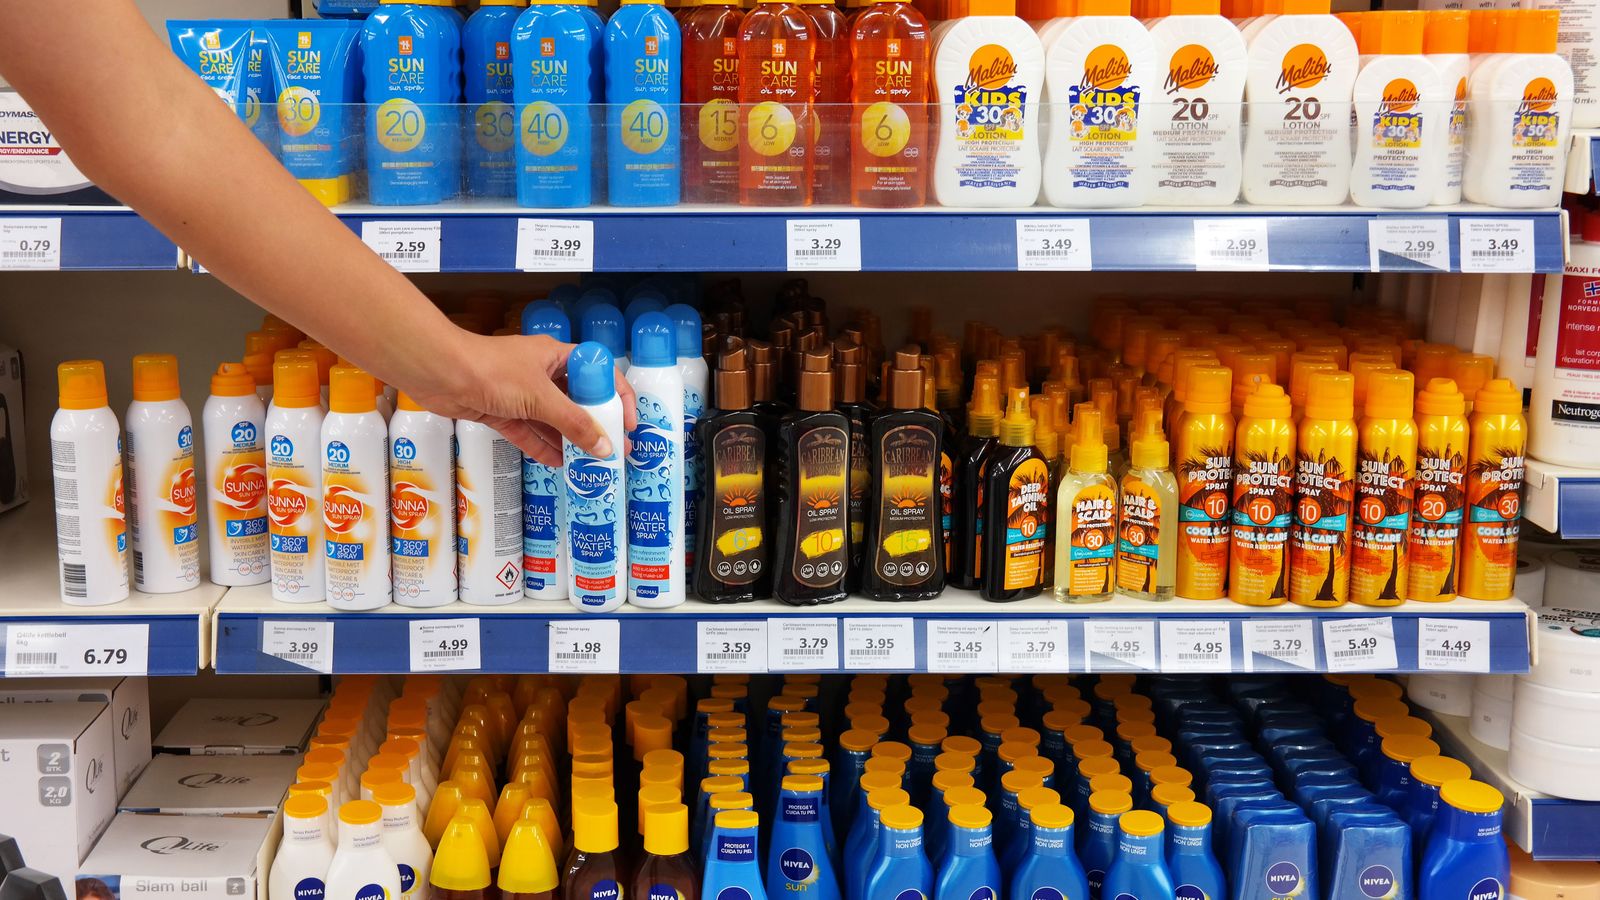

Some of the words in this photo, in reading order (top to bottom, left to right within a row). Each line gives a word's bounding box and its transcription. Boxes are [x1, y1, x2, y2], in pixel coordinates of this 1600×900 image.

[287, 50, 321, 63] SUN
[287, 62, 321, 74] CARE
[388, 58, 425, 72] SUN
[530, 60, 568, 75] SUN
[875, 60, 912, 75] SUN
[388, 72, 425, 85] CARE
[530, 74, 568, 87] CARE
[875, 74, 911, 88] CARE
[964, 56, 1018, 94] Malibu
[1078, 56, 1132, 94] Malibu
[1164, 56, 1219, 95] Malibu
[1276, 56, 1332, 95] Malibu
[965, 91, 1022, 109] KIDS
[1079, 91, 1136, 109] KIDS
[1378, 88, 1421, 115] Malibu
[1519, 87, 1558, 114] Malibu
[284, 97, 314, 122] 30
[1171, 97, 1209, 122] 20
[1284, 96, 1321, 121] 20
[976, 106, 1002, 125] 30
[1090, 106, 1116, 125] 30
[1380, 115, 1419, 127] KIDS
[1521, 114, 1559, 127] KIDS
[385, 110, 420, 136] 20
[527, 111, 563, 140] 40
[629, 111, 664, 138] 40
[710, 109, 737, 137] 15
[761, 114, 778, 139] 6
[875, 113, 892, 139] 6
[1386, 126, 1406, 137] 30
[1527, 125, 1545, 137] 50
[20, 240, 51, 251] 0.79
[395, 241, 426, 253] 2.59
[550, 239, 582, 251] 3.99
[811, 238, 842, 250] 3.29
[1041, 238, 1073, 250] 3.49
[1226, 239, 1257, 251] 2.99
[1404, 240, 1435, 252] 2.99
[1487, 239, 1519, 251] 3.49
[1565, 266, 1589, 274] MAXI
[1566, 321, 1596, 332] intense
[1575, 348, 1585, 356] lait
[234, 428, 254, 442] 20
[272, 442, 290, 456] 20
[328, 449, 347, 462] 20
[395, 445, 413, 457] 30
[883, 447, 934, 464] CARIBBEAN
[801, 448, 846, 465] CARIBBEAN
[1205, 456, 1231, 470] SUN
[1500, 456, 1524, 470] SUN
[1250, 461, 1278, 474] SUN
[1421, 457, 1450, 470] SUN
[569, 467, 611, 482] SUNNA
[1236, 473, 1291, 488] PROTECT
[1020, 482, 1041, 495] DEEP
[1205, 482, 1229, 491] SPRAY
[1248, 487, 1276, 496] SPRAY
[1420, 482, 1447, 493] SPRAY
[269, 495, 305, 508] SUNNA
[392, 497, 426, 511] SUNNA
[1011, 492, 1047, 508] TANNING
[1075, 499, 1103, 512] HAIR
[1103, 499, 1113, 509] &
[1207, 498, 1225, 515] 10
[325, 501, 361, 515] SUNNA
[723, 506, 735, 515] OIL
[736, 505, 757, 515] SPRAY
[807, 508, 820, 517] OIL
[820, 507, 839, 516] SPRAY
[890, 508, 903, 516] OIL
[904, 507, 925, 516] SPRAY
[1023, 501, 1038, 513] OIL
[1251, 505, 1272, 521] 10
[1299, 504, 1317, 521] 10
[1362, 504, 1381, 521] 10
[1421, 500, 1444, 517] 20
[1501, 499, 1519, 515] 30
[630, 510, 666, 522] FACIAL
[1077, 511, 1112, 523] SCALP
[630, 521, 666, 532] WATER
[1021, 521, 1036, 536] 10
[573, 530, 612, 543] FACIAL
[636, 531, 658, 540] SPRAY
[734, 529, 748, 552] 6
[814, 531, 833, 553] 10
[896, 530, 919, 551] 15
[1086, 534, 1103, 547] 30
[1130, 531, 1144, 545] 30
[574, 540, 611, 551] WATER
[1236, 540, 1255, 548] WATER
[580, 549, 604, 558] SPRAY
[36, 631, 67, 639] kettlebell
[288, 642, 319, 653] 3.99
[438, 639, 469, 651] 4.99
[572, 642, 602, 653] 1.98
[722, 642, 752, 653] 3.59
[799, 638, 829, 649] 3.79
[865, 638, 895, 649] 3.95
[953, 641, 983, 652] 3.45
[1026, 641, 1056, 652] 3.79
[1110, 641, 1140, 652] 4.95
[1193, 642, 1223, 653] 4.95
[1272, 639, 1302, 651] 3.79
[1348, 638, 1378, 650] 5.49
[1441, 640, 1472, 651] 4.49
[83, 648, 128, 665] 6.79
[48, 751, 61, 766] 2
[44, 786, 68, 799] 2,0
[1131, 847, 1147, 855] UNGE
[783, 860, 810, 870] NIVEA
[1270, 874, 1297, 882] NIVEA
[1363, 878, 1390, 886] NIVEA
[181, 879, 208, 893] ball
[297, 888, 323, 897] NIVEA
[784, 882, 808, 892] sun
[593, 888, 617, 899] NIVEA
[1473, 891, 1498, 900] NIVEA
